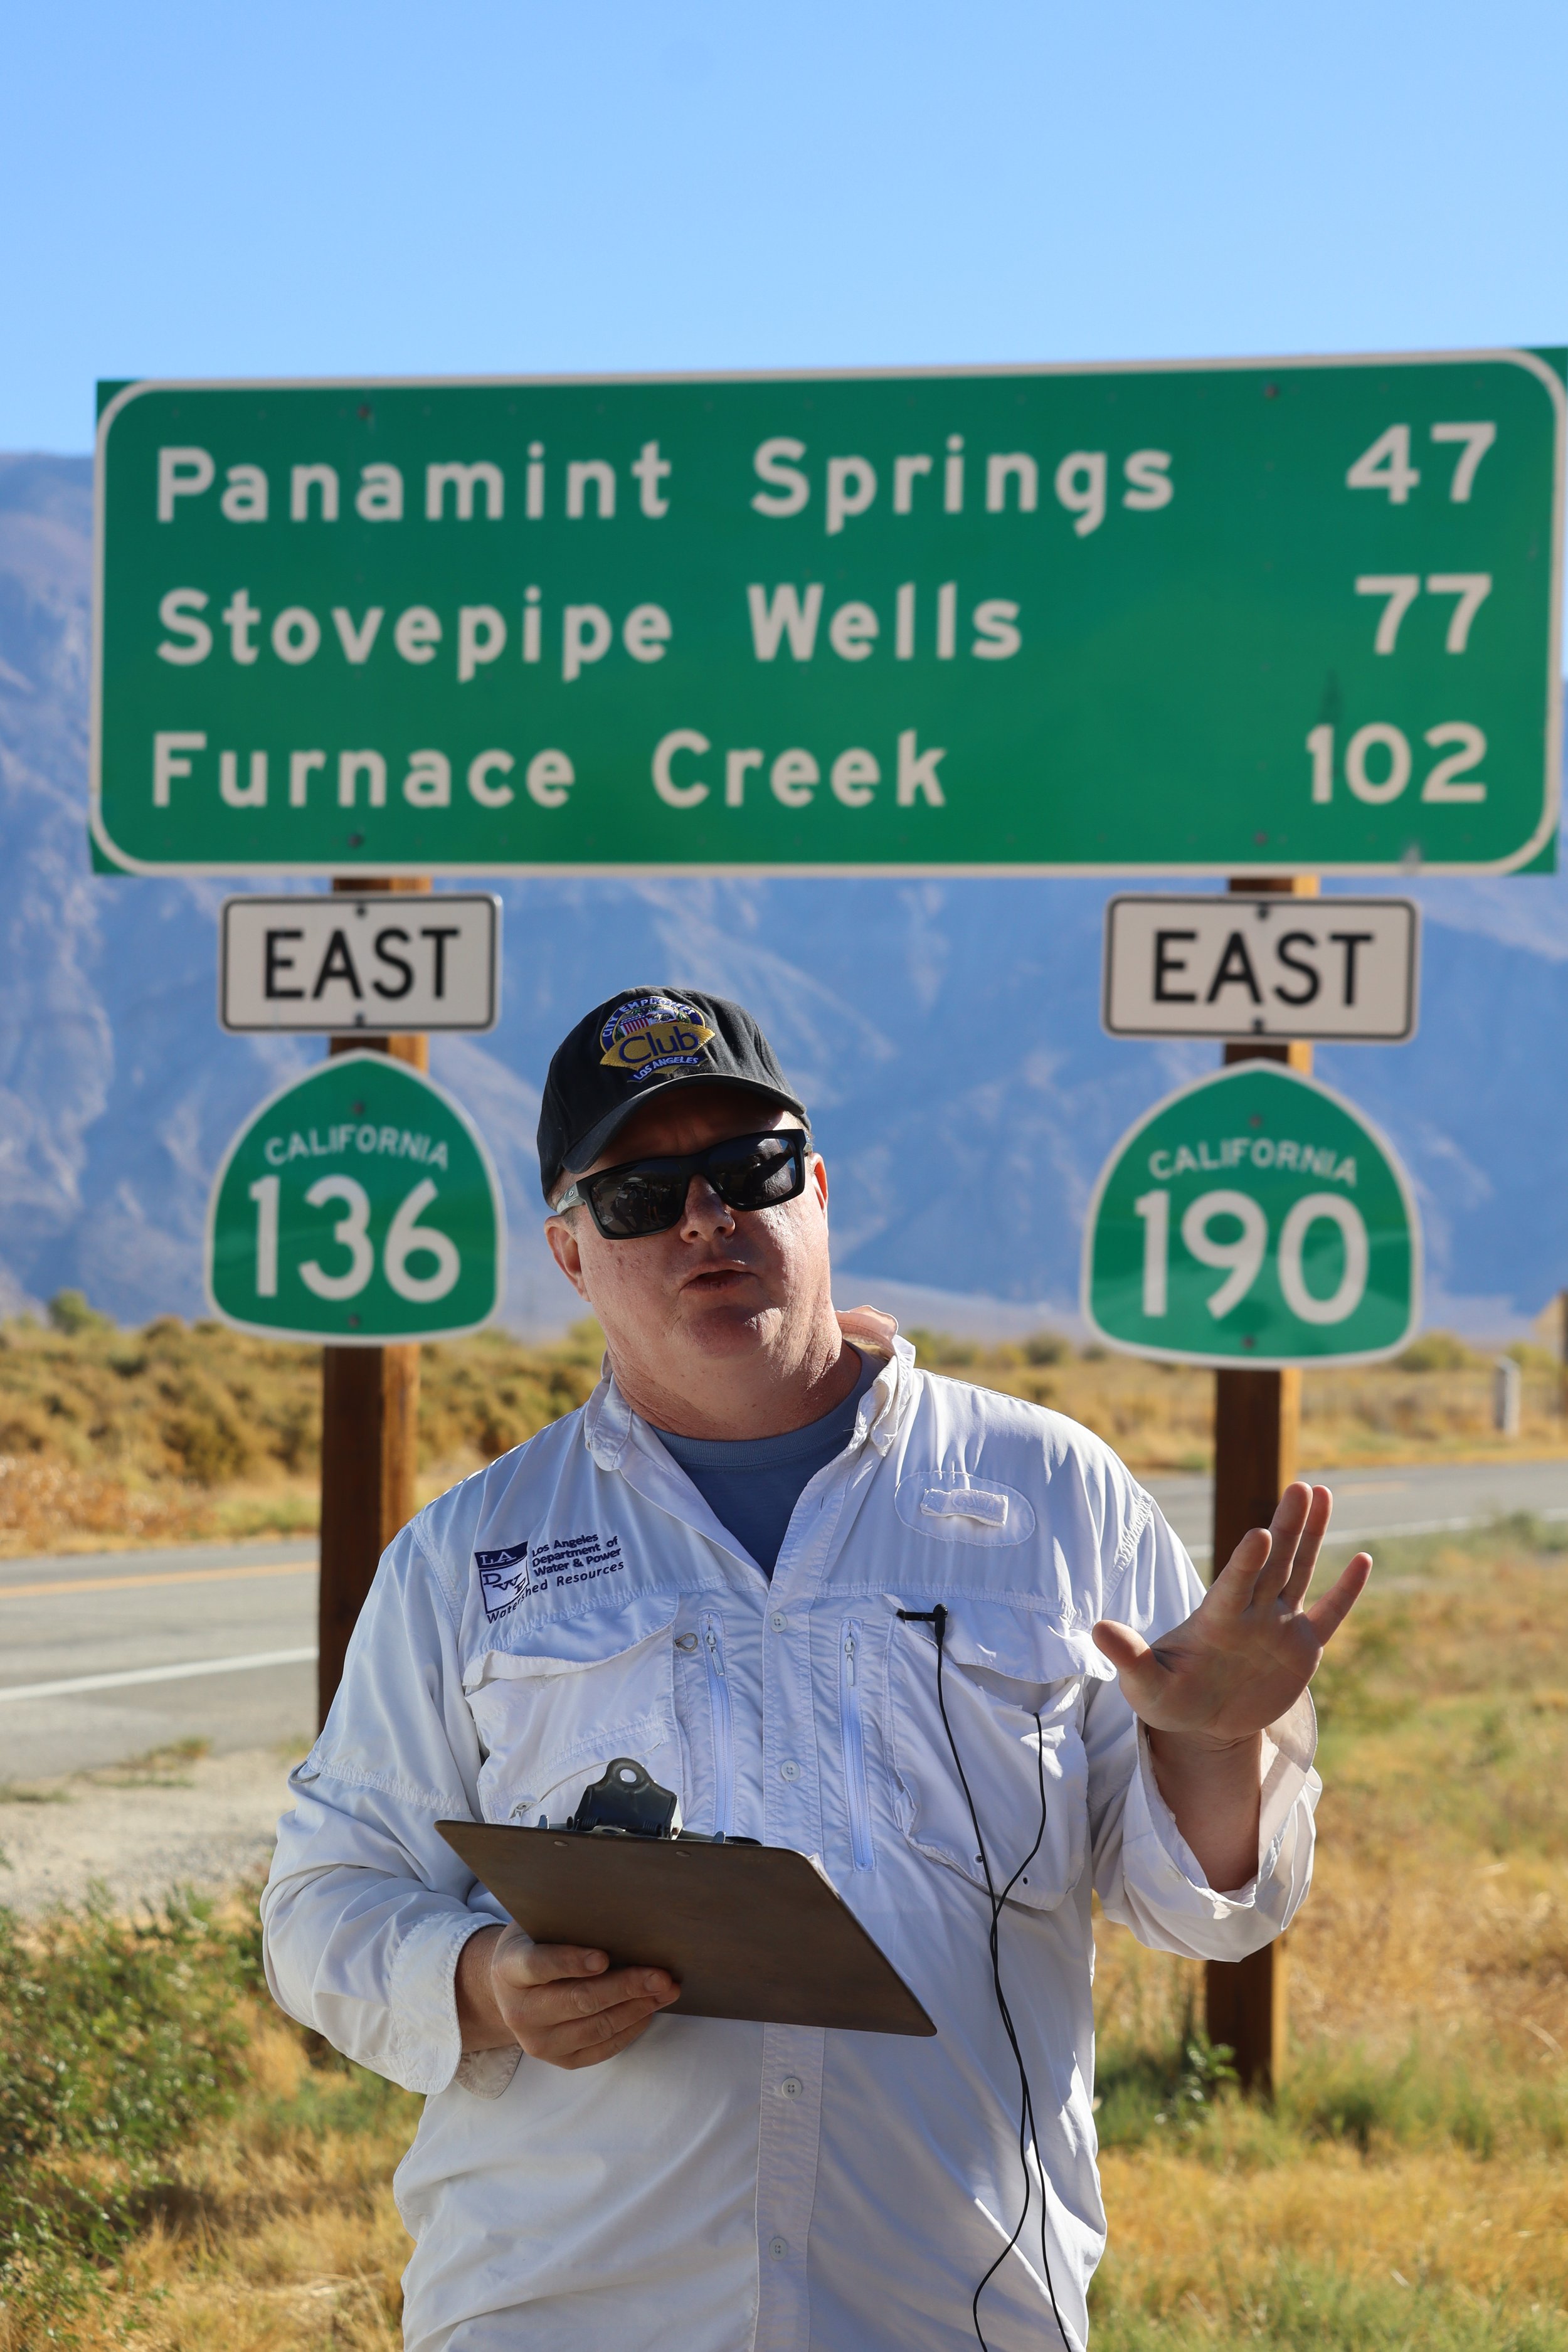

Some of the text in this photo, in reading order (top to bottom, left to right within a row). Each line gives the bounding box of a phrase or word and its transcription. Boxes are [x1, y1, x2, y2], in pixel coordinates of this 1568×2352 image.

[159, 422, 1496, 536] Panamint Springs 47
[157, 573, 1491, 682] Stovepipe Wells 77
[154, 722, 1486, 808] Furnace Creek 102
[265, 927, 460, 1000] EAST
[1153, 930, 1374, 1007] EAST
[603, 998, 696, 1037] CITY EMPLOYEES
[618, 1025, 700, 1063] Club
[633, 1056, 699, 1080] LOS ANGELES
[265, 1123, 449, 1172] CALIFORNIA
[1148, 1137, 1359, 1187] CALIFORNIA
[250, 1175, 460, 1303] 136
[1135, 1190, 1369, 1325] 190
[480, 1551, 517, 1565] LA
[532, 1534, 599, 1557] Los Angeles
[532, 1535, 618, 1567] Department of
[533, 1548, 622, 1577] Water & Power
[487, 1561, 625, 1624] Watershed Resources
